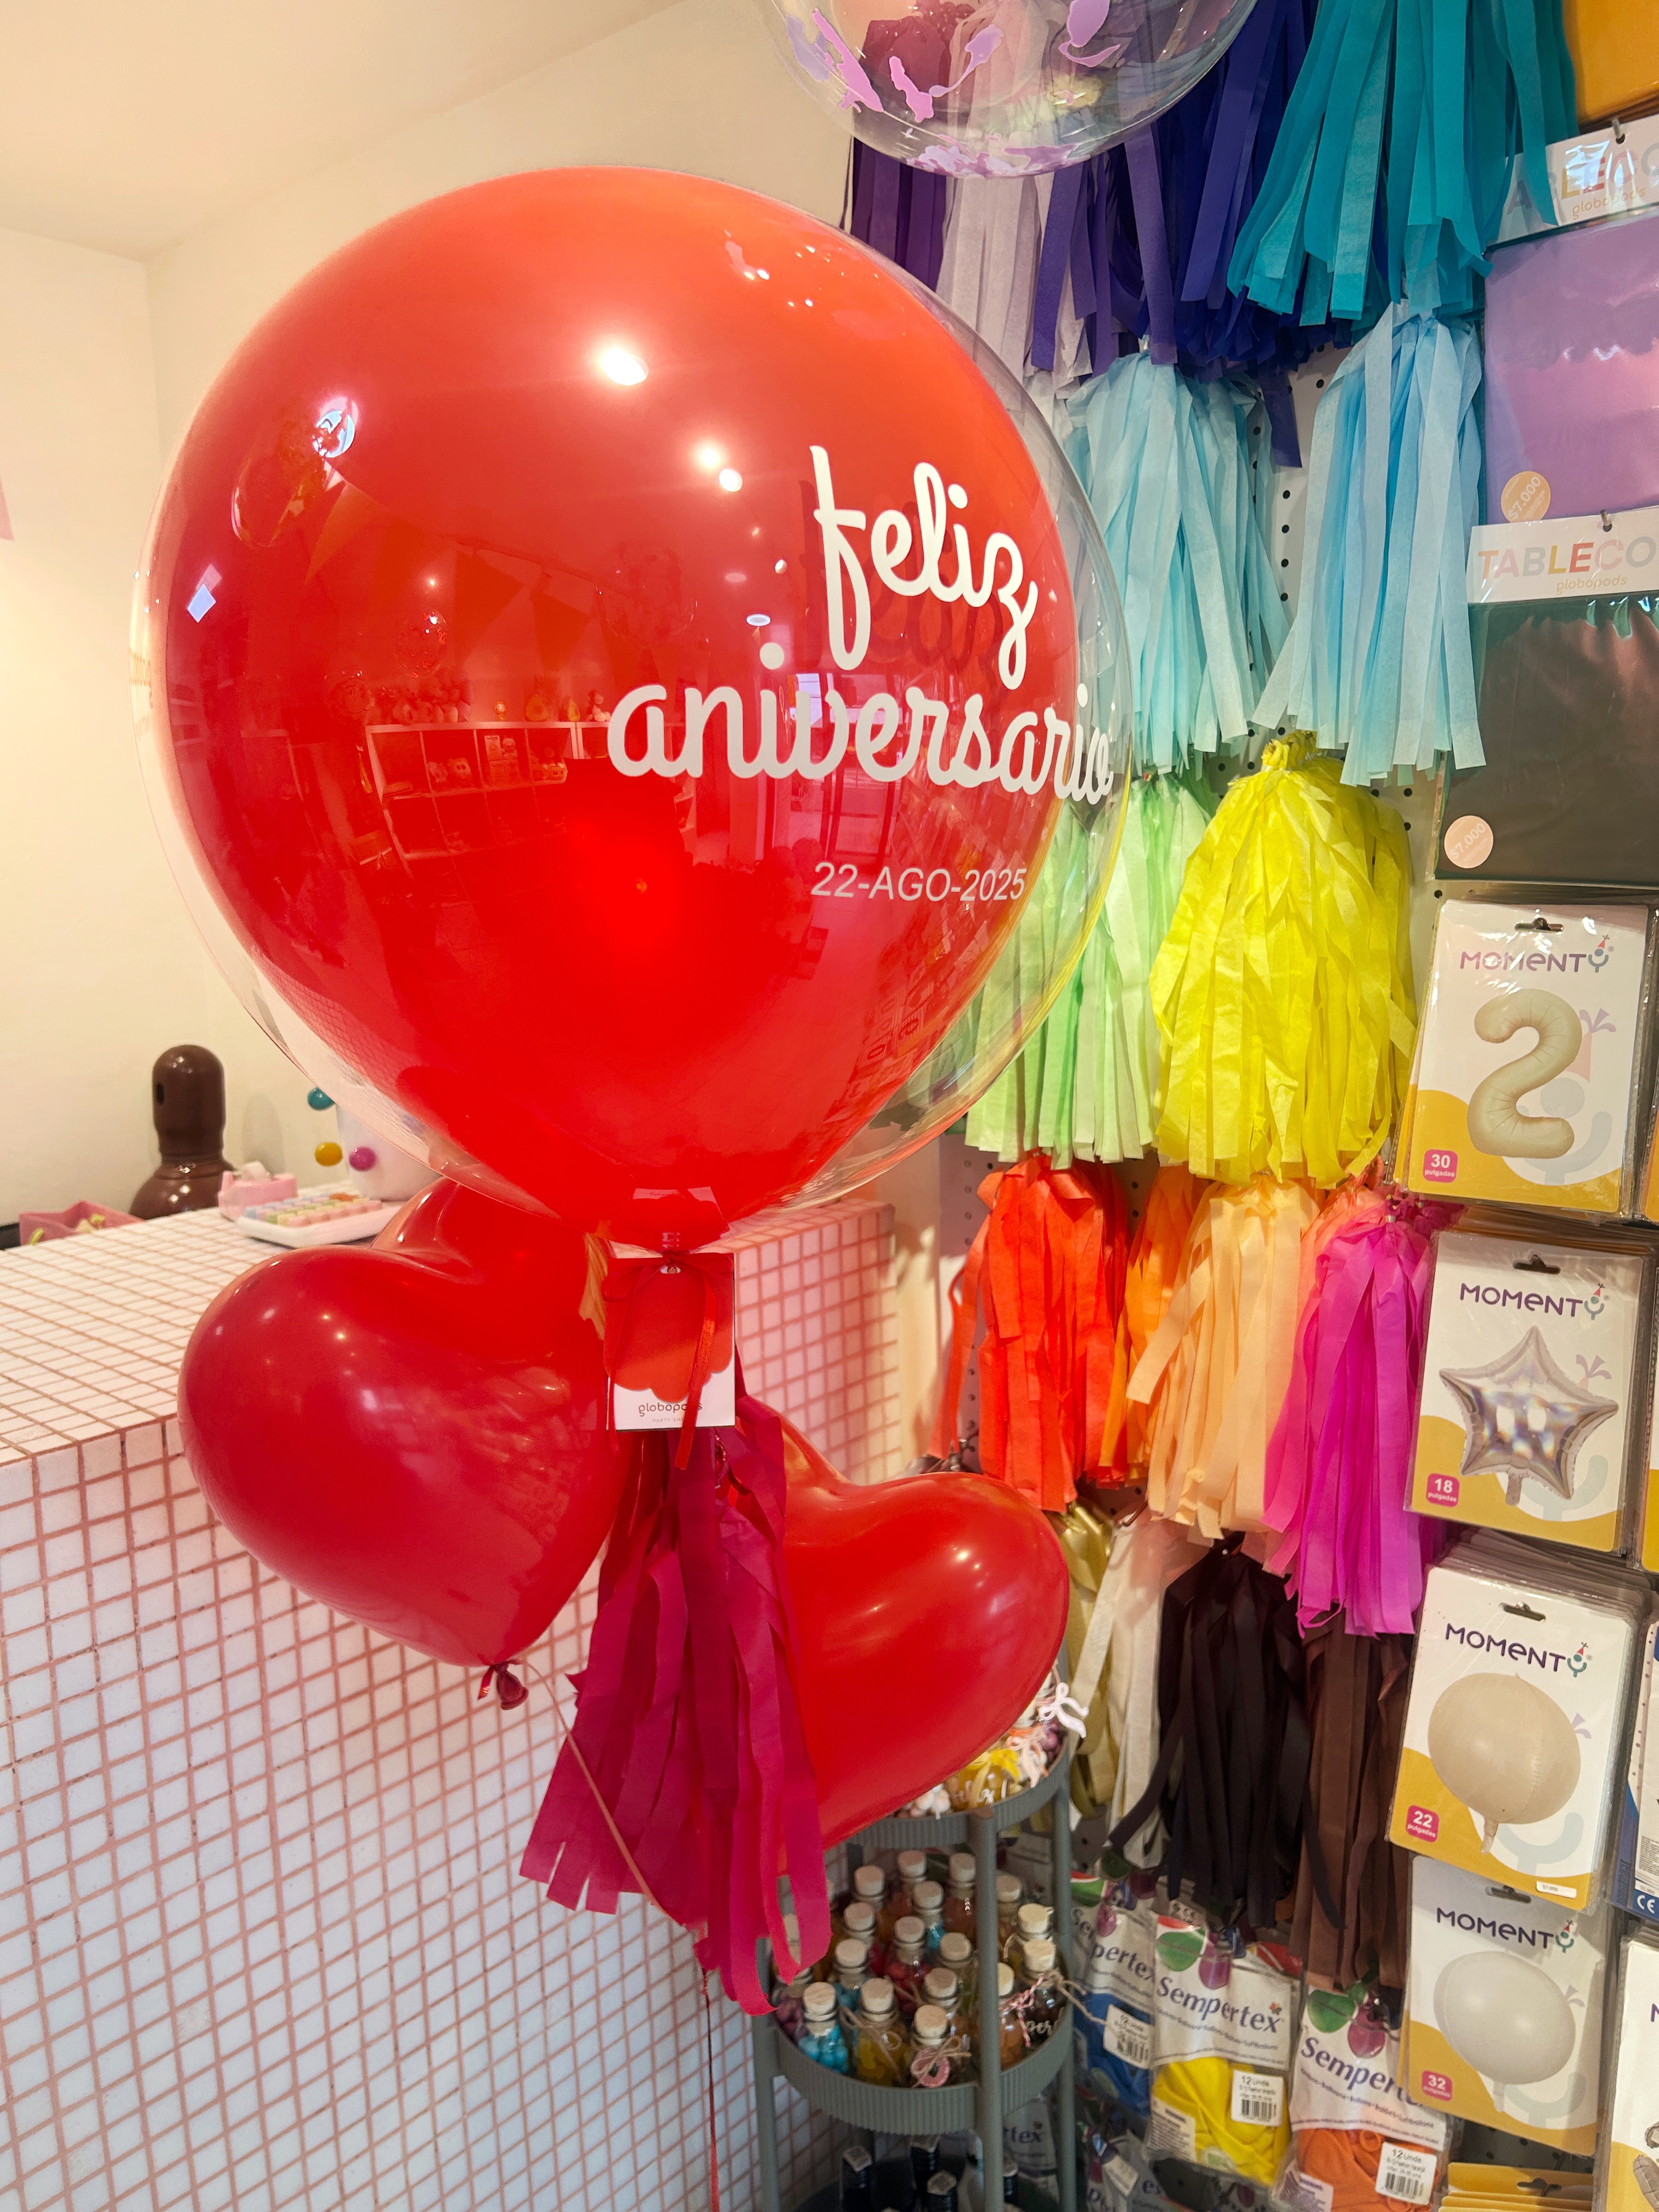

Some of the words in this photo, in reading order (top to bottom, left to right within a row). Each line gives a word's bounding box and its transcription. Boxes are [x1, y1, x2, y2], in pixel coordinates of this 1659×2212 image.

[1508, 476, 1541, 520] $7.000
[810, 445, 1039, 690] feliz
[1477, 535, 1657, 579] TABLECO
[1556, 574, 1628, 596] globopods
[607, 642, 1114, 805] aniversario
[1449, 823, 1486, 860] $7.000
[810, 862, 1027, 902] 22-AGO-2025
[1431, 1153, 1451, 1169] 30
[1425, 1169, 1455, 1177] pulgadas
[638, 1402, 703, 1417] globopos
[1435, 1478, 1453, 1494] 18
[1413, 1810, 1433, 1829] 22
[1156, 1976, 1280, 2033] Sempertex
[1428, 2074, 1446, 2091] 32
[1392, 2149, 1403, 2160] 12
